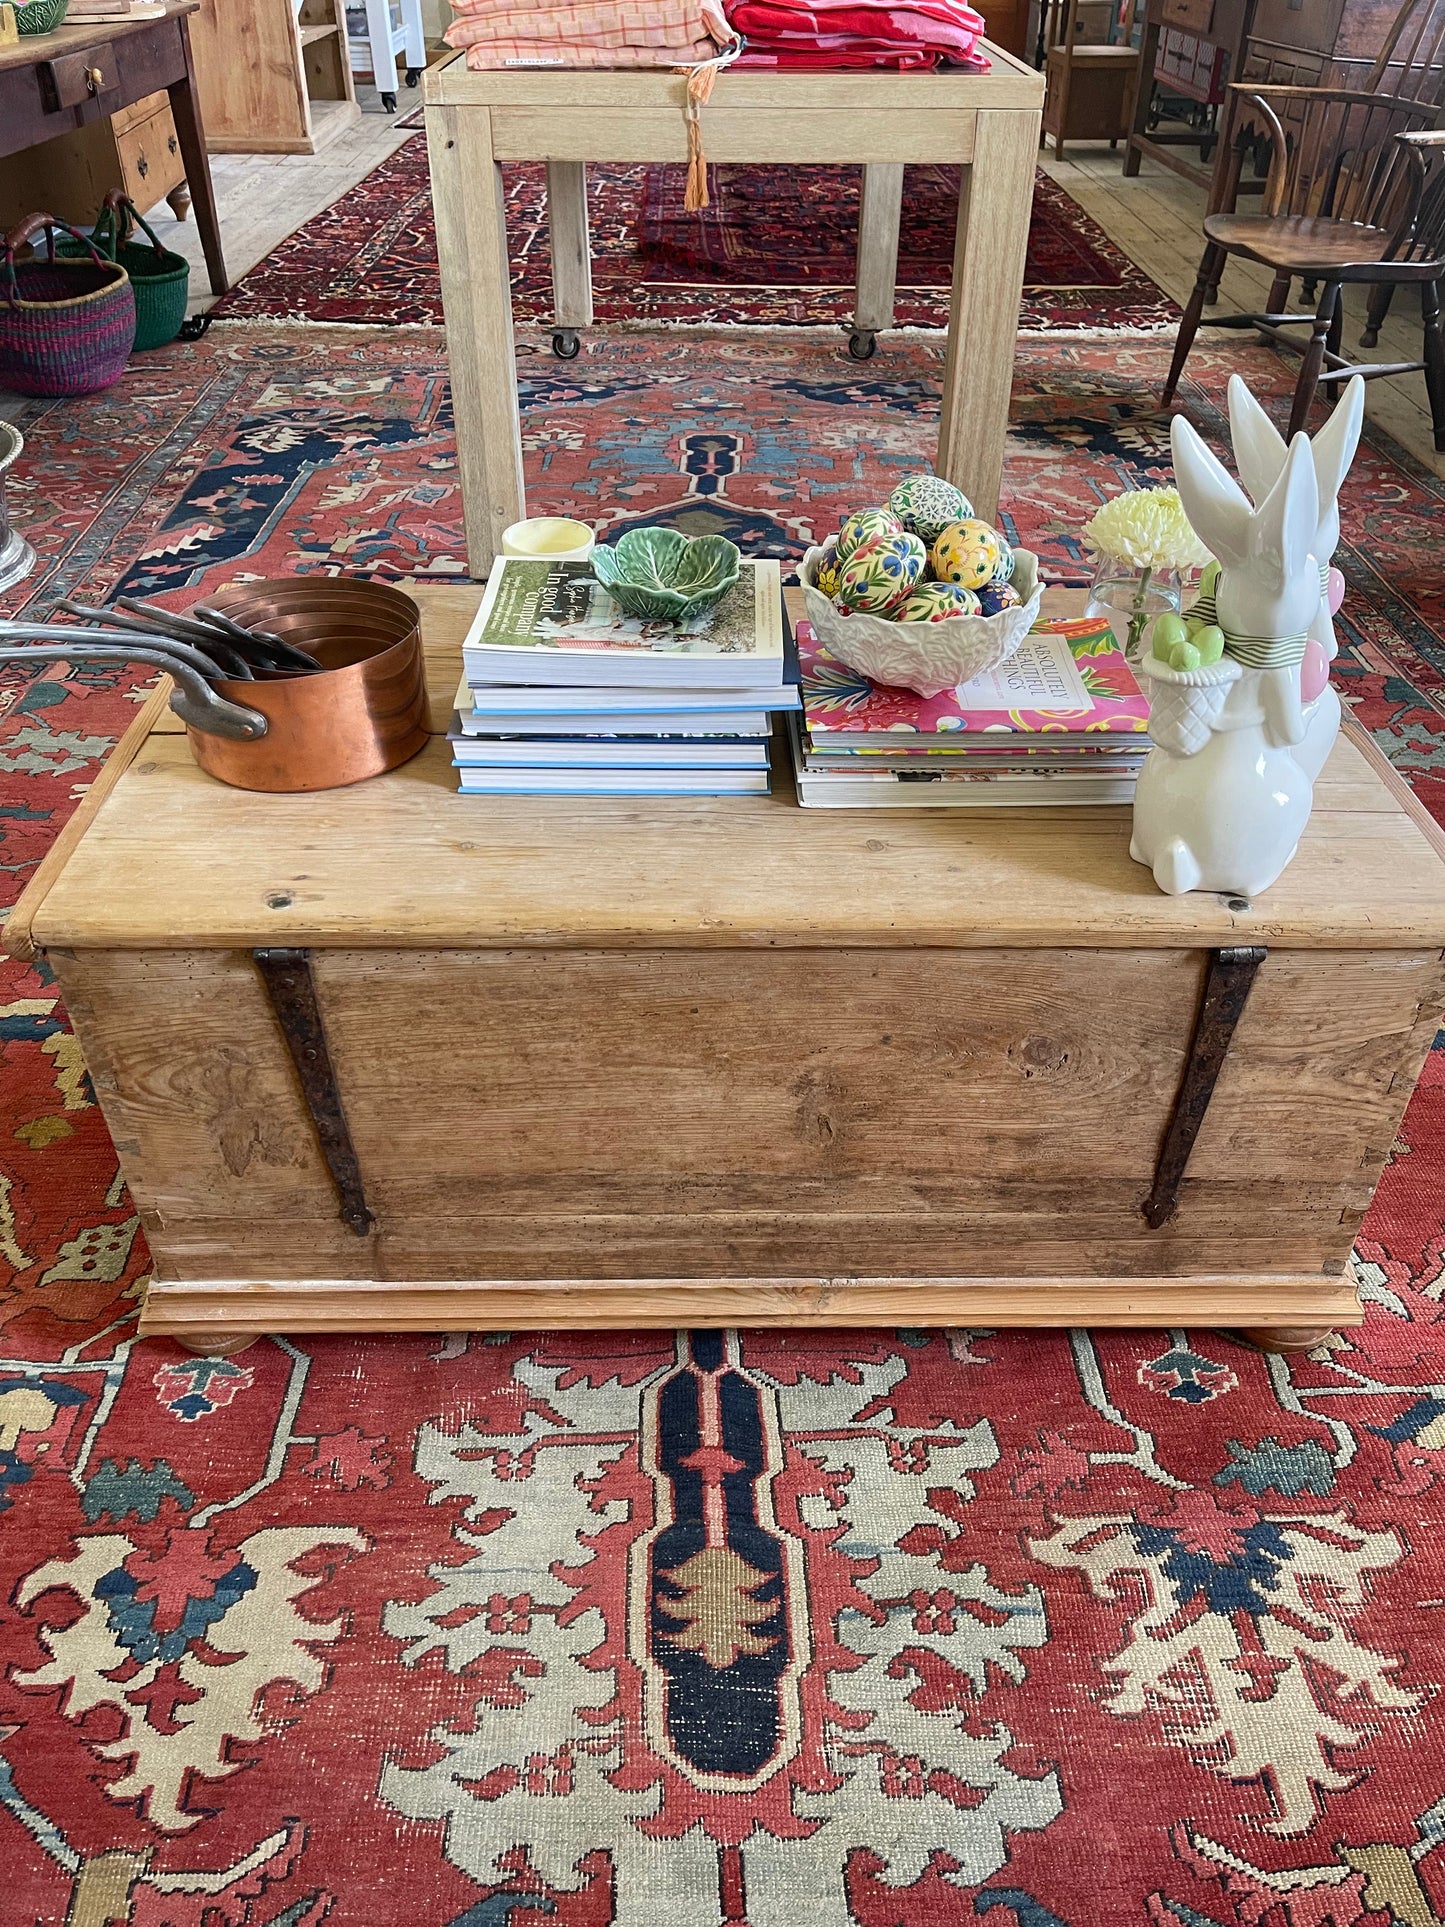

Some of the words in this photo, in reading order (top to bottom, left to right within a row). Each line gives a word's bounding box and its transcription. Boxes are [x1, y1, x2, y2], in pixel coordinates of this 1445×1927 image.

[538, 586, 563, 613] good
[548, 573, 569, 585] In
[508, 591, 540, 637] company
[1016, 647, 1047, 696] BEAUTIFUL
[1032, 643, 1069, 699] ABSOLUTELY
